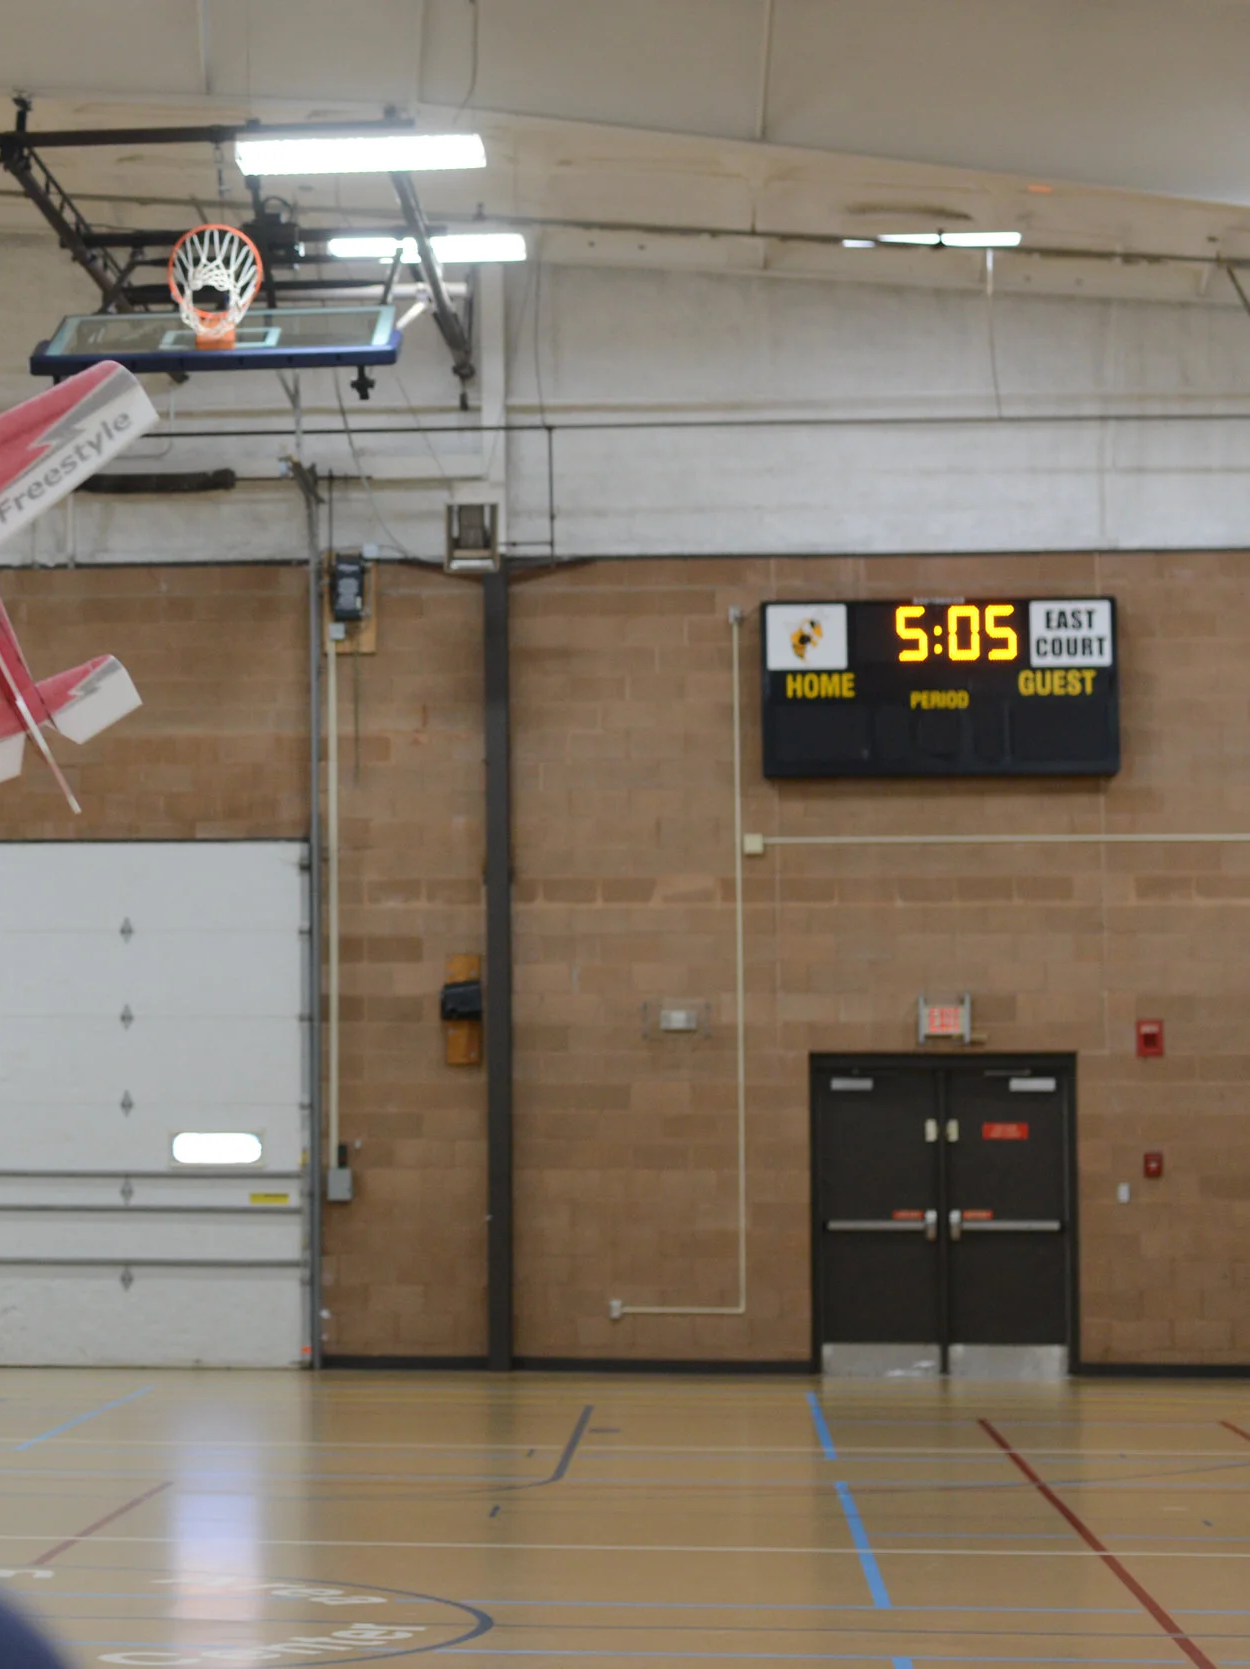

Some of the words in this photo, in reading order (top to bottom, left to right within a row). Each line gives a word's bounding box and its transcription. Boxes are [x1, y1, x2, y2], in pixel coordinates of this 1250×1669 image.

[895, 604, 1018, 662] 5:05
[1045, 609, 1096, 630] EAST
[1036, 636, 1106, 657] COURT
[786, 672, 856, 699] HOME
[1018, 668, 1097, 697] GUEST
[910, 690, 970, 710] PERIOD
[97, 1623, 426, 1666] Center
